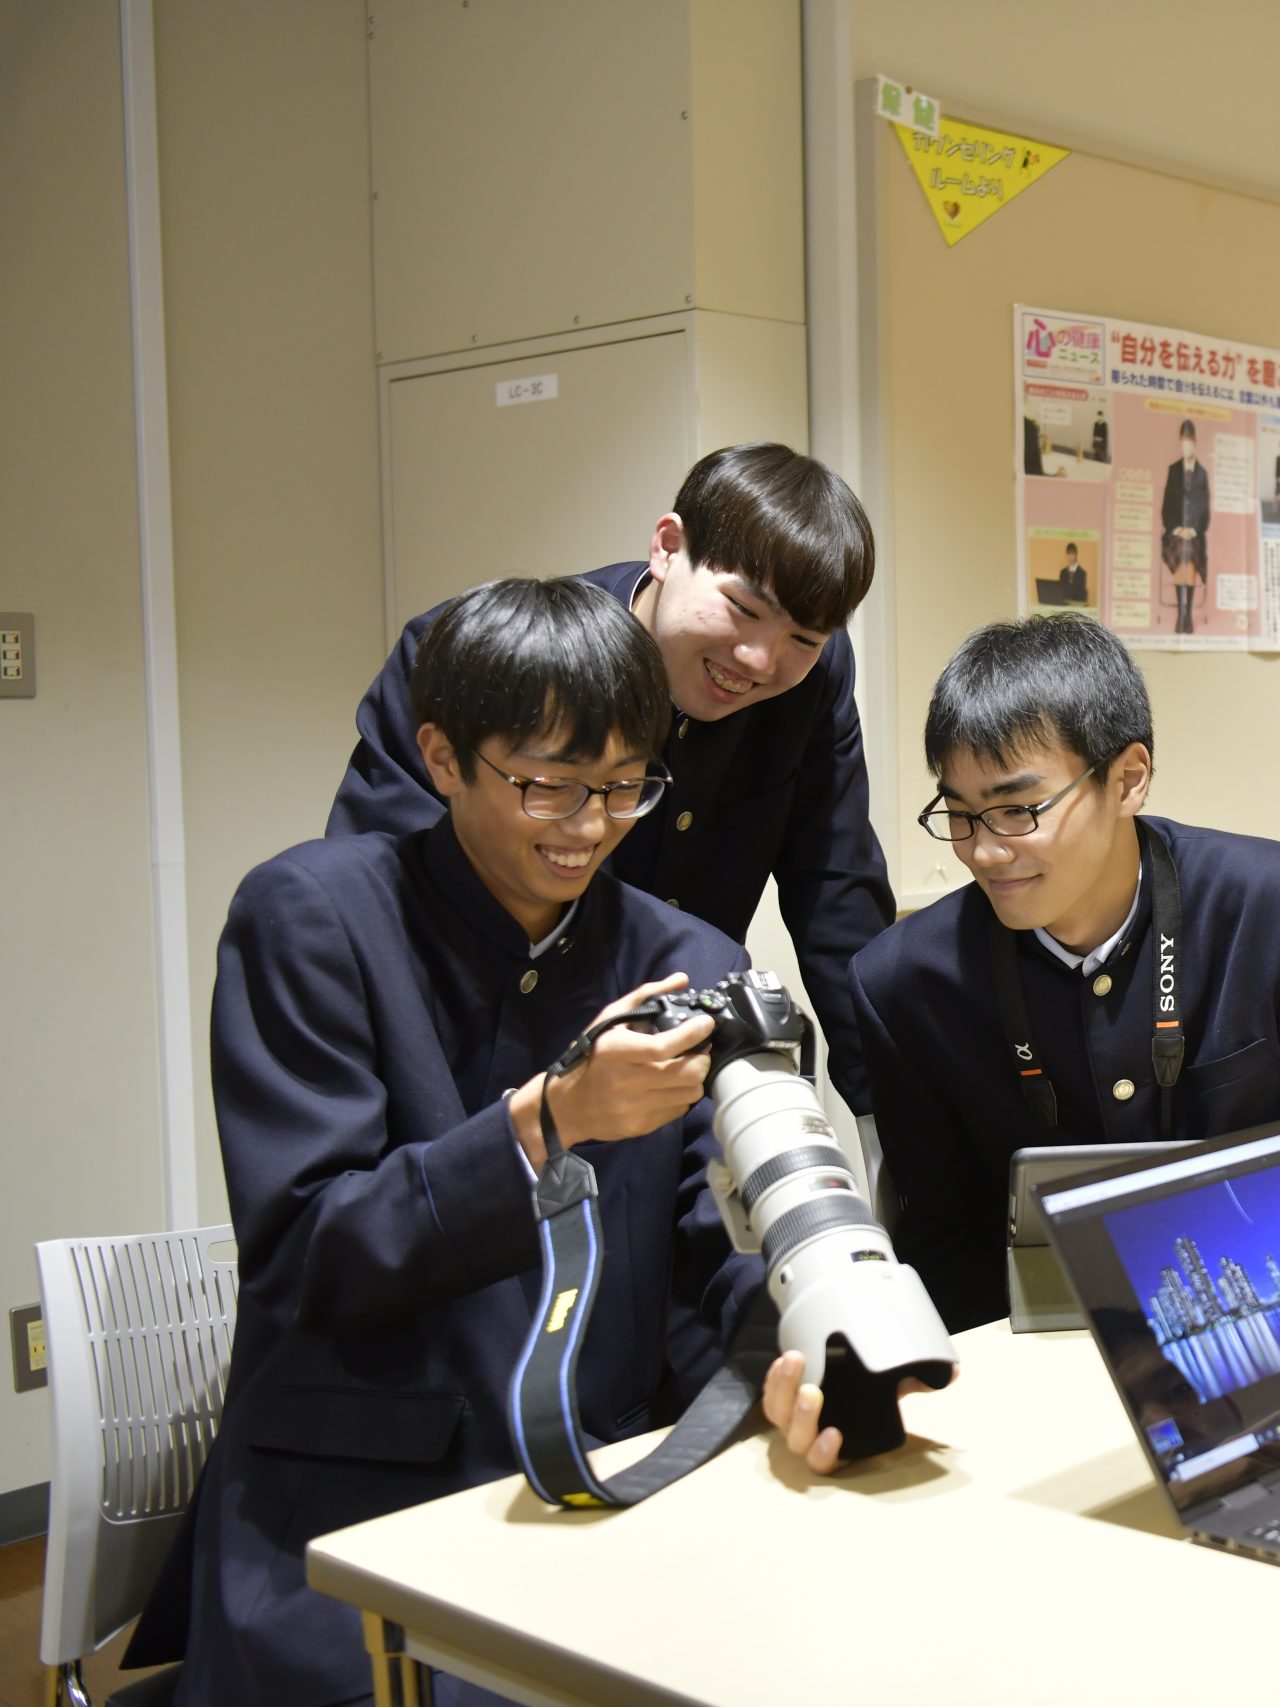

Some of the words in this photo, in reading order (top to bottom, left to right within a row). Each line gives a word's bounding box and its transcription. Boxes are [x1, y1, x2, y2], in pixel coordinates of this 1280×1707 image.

[929, 167, 1004, 202] ルームより
[1159, 933, 1176, 1013] SONY
